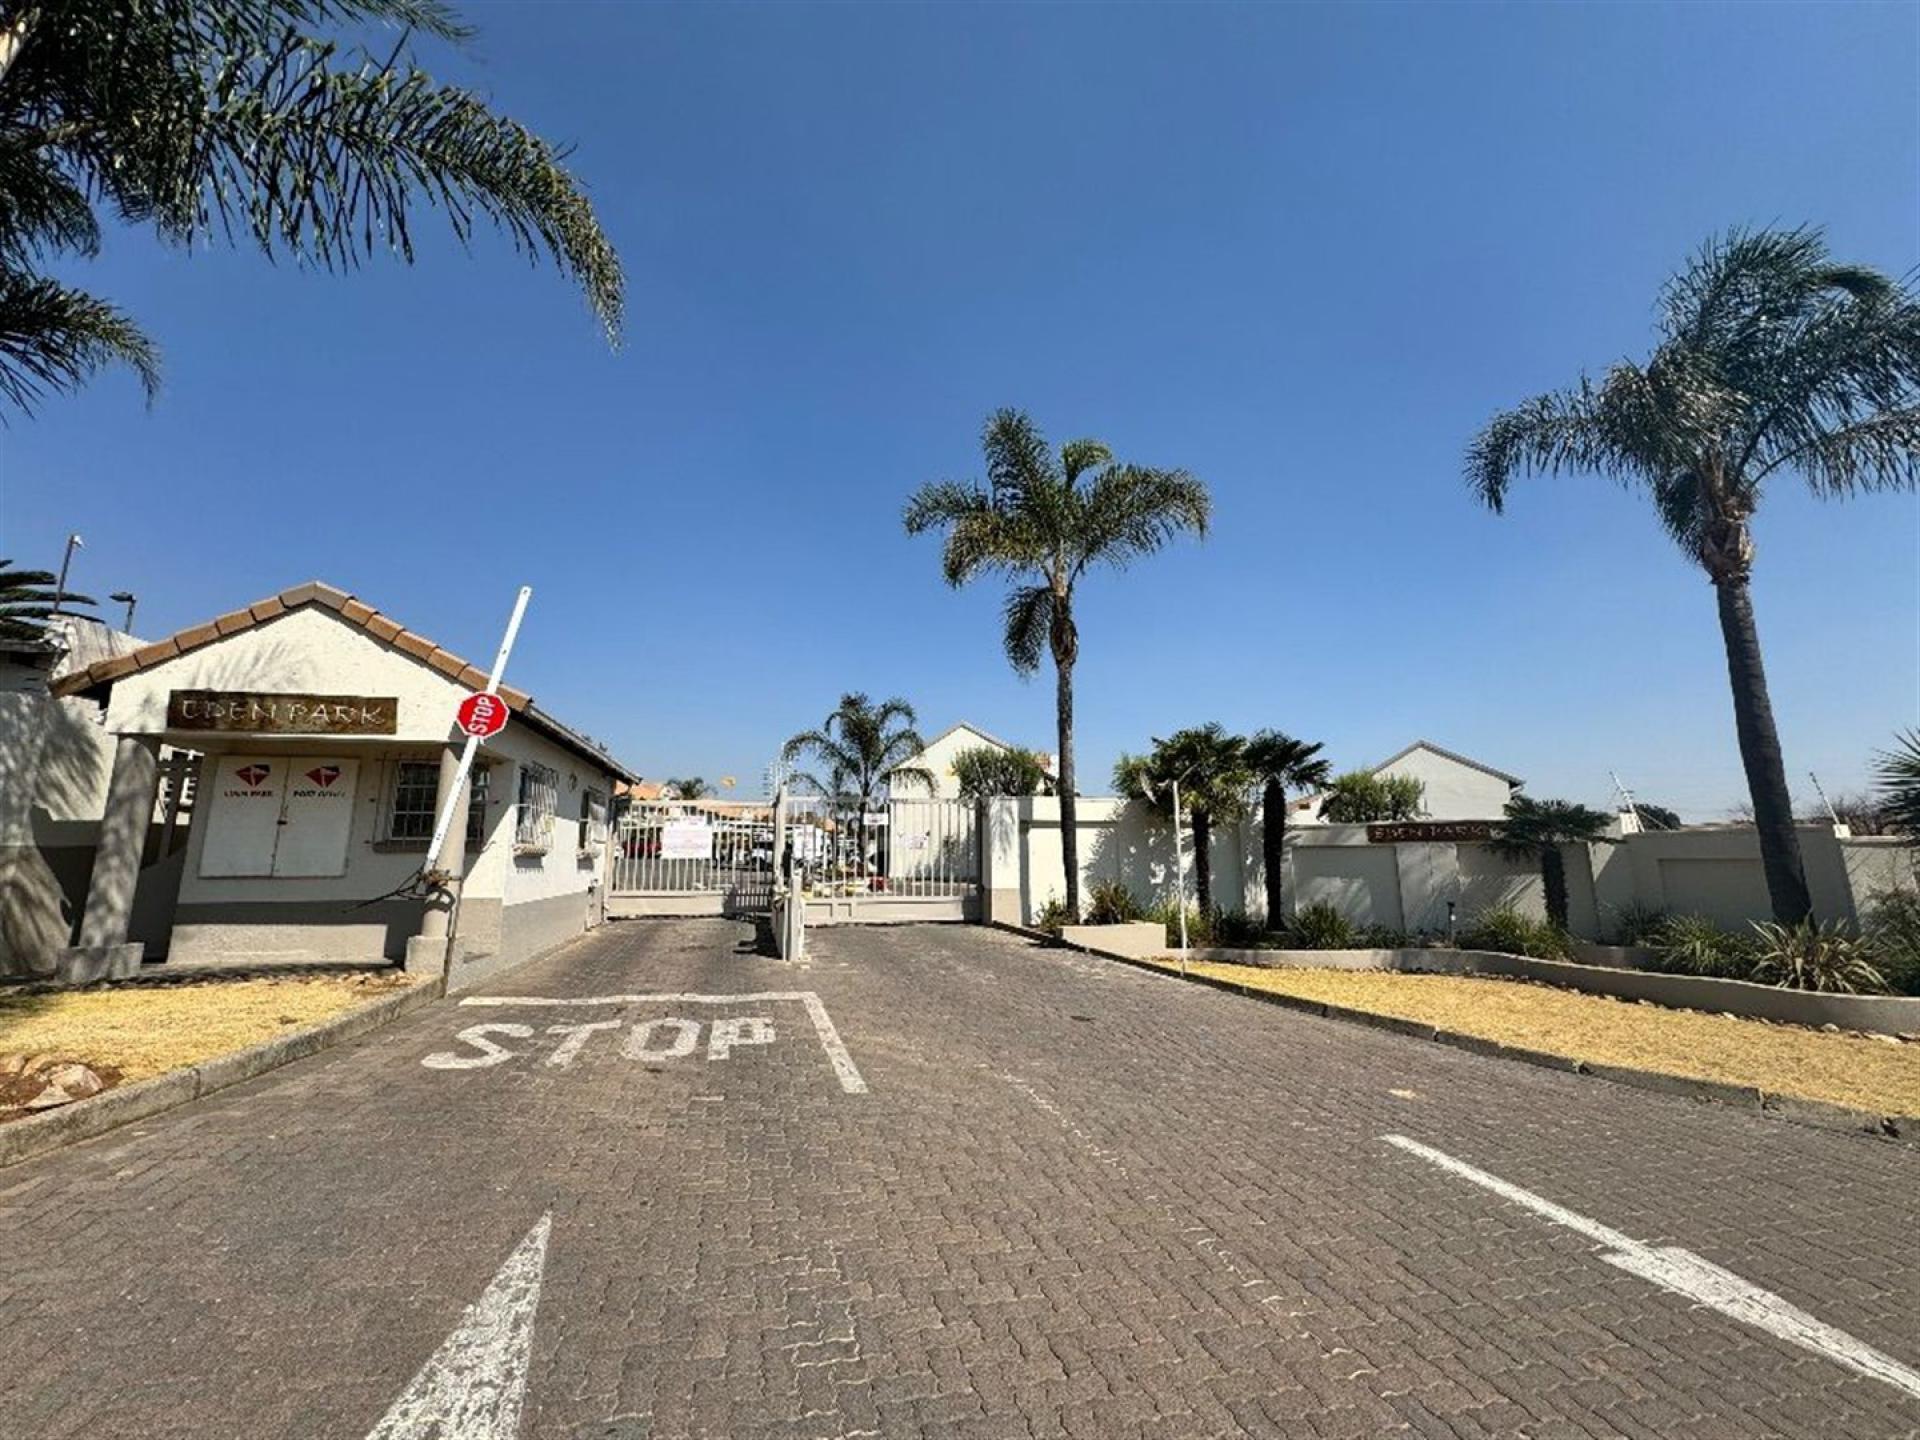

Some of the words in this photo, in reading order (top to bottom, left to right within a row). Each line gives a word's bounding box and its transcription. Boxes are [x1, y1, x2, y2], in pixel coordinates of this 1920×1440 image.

[288, 703, 385, 725] PARK
[468, 696, 495, 733] STOP
[420, 1017, 777, 1068] STOP
